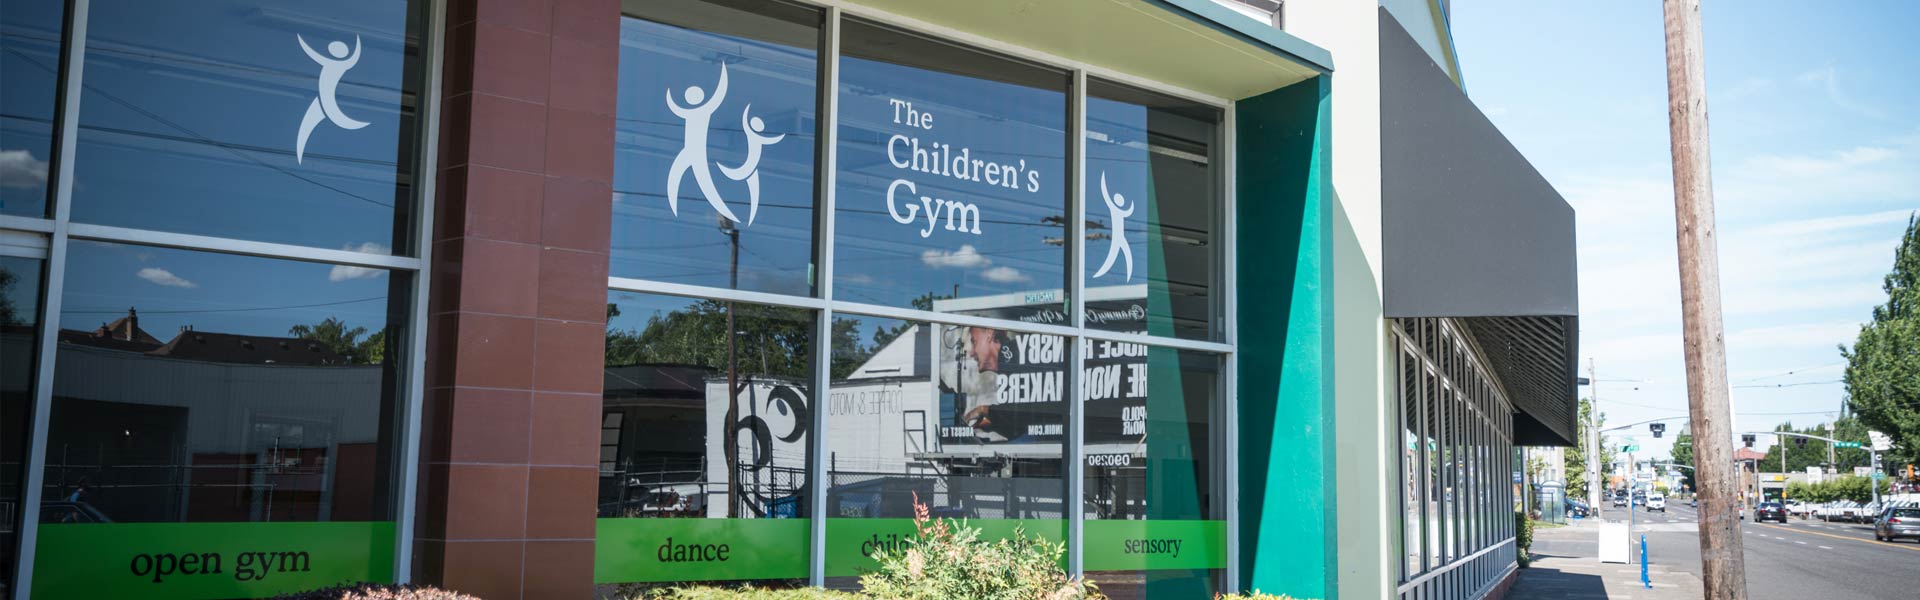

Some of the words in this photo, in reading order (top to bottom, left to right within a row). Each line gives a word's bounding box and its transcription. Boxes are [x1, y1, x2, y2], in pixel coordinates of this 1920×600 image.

[890, 98, 933, 130] The
[887, 134, 1040, 193] Children’s
[886, 179, 982, 238] Gym
[657, 537, 730, 563] dance
[1124, 539, 1182, 558] sensory
[130, 552, 222, 583] open
[234, 550, 311, 581] gym
